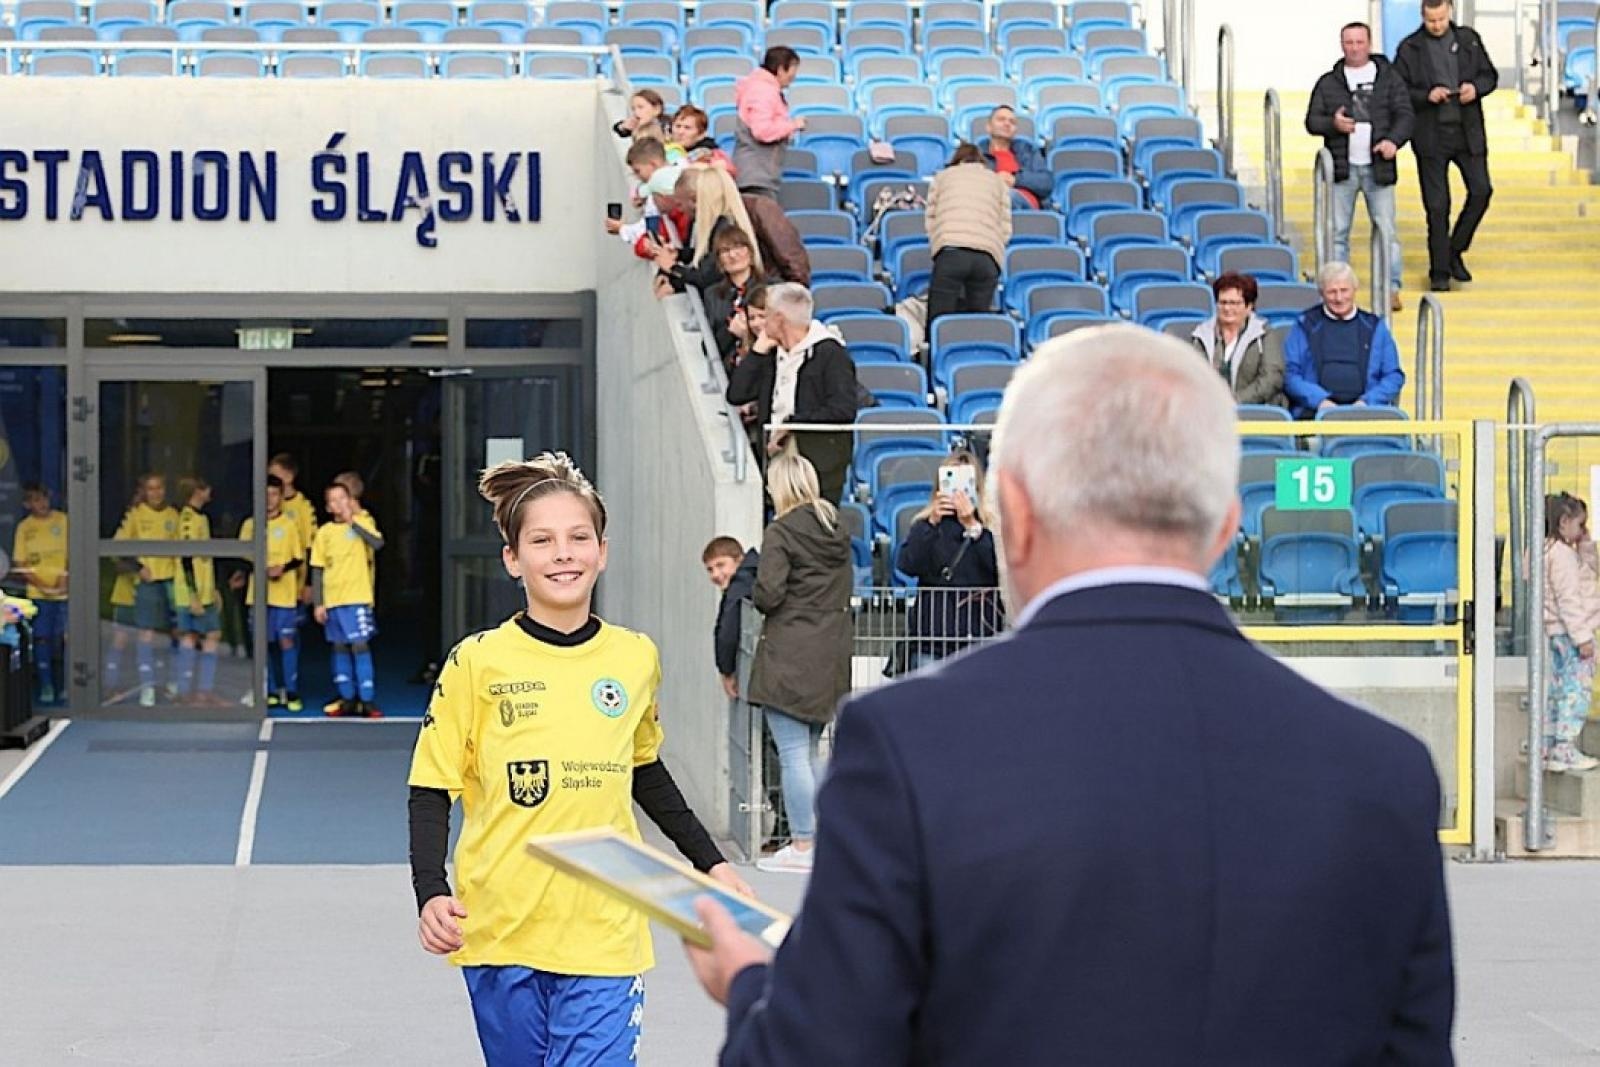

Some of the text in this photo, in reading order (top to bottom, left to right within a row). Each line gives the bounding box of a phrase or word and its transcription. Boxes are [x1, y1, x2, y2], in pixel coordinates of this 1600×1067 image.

[0, 132, 542, 248] STADION ŚLĄSKI
[1291, 465, 1335, 502] 15
